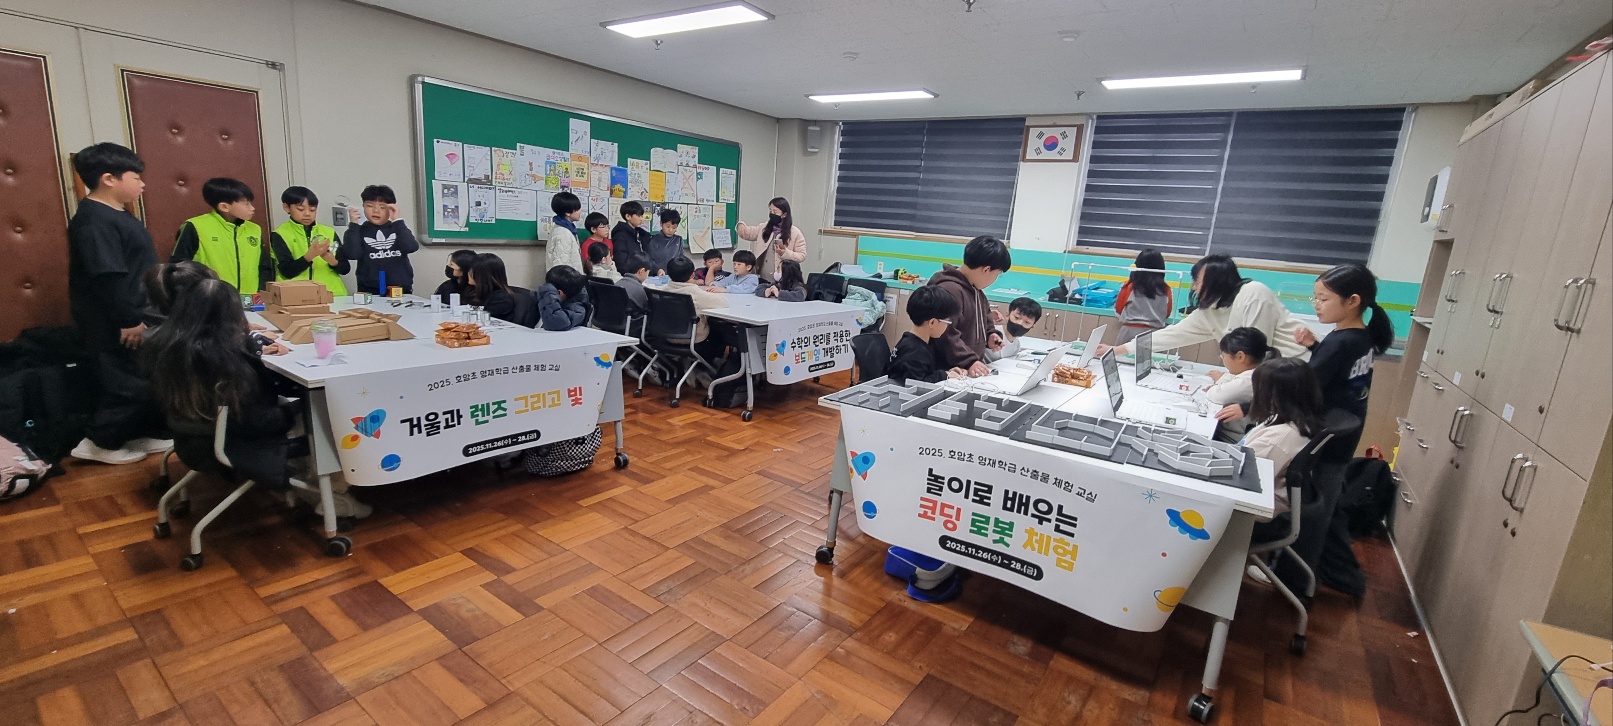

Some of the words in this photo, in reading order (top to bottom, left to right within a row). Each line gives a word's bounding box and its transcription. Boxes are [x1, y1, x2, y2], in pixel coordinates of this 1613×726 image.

[790, 336, 811, 351] 수학의
[812, 332, 831, 347] 원리를
[832, 329, 851, 343] 적용한
[794, 349, 820, 365] 보드게임
[821, 343, 849, 358] 개발하기
[427, 378, 453, 391] 2025.
[455, 371, 478, 384] 호암초
[480, 366, 509, 379] 영재학급
[511, 364, 532, 374] 산출물
[533, 363, 547, 372] 체험
[548, 364, 561, 372] 교실
[400, 408, 463, 437] 거울과
[469, 399, 508, 426] 렌즈
[513, 389, 562, 415] 그리고
[566, 386, 583, 407] 빛
[468, 438, 512, 454] 2025.11.26(수)
[918, 446, 946, 459] 2025.
[948, 450, 975, 464] 호암초
[977, 455, 1017, 474] 영재학급
[1019, 466, 1050, 484] 산출물
[1052, 476, 1074, 493] 체험
[1075, 486, 1098, 504] 교실
[926, 467, 994, 507] 놀이로
[1001, 489, 1078, 538] 배우는
[917, 496, 962, 532] 코딩
[969, 511, 1015, 548] 로봇
[1022, 526, 1079, 572] 체험
[945, 540, 1001, 564] 2025.11.26(수)
[1010, 560, 1038, 577] 28.(금)
